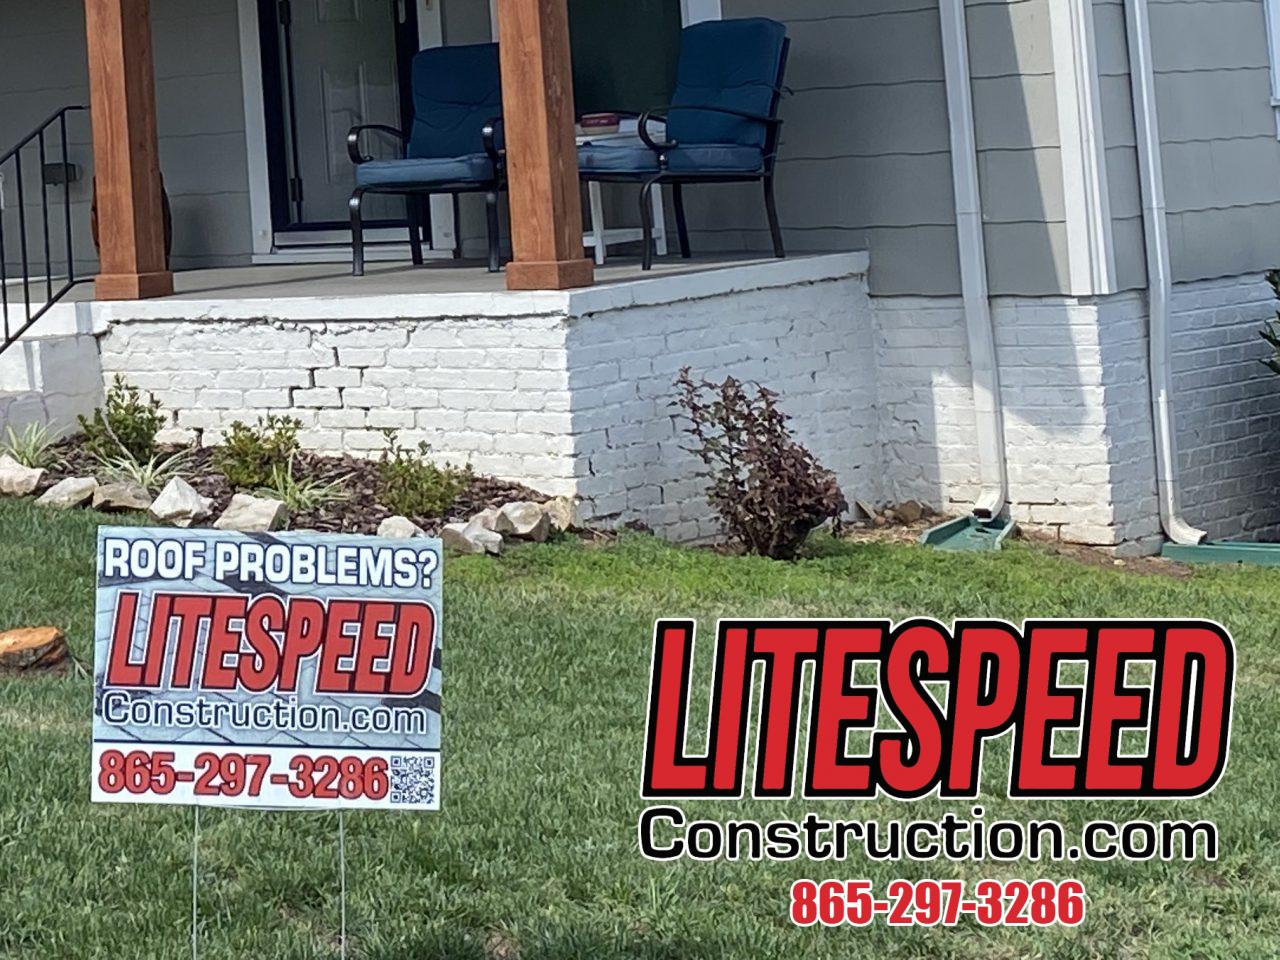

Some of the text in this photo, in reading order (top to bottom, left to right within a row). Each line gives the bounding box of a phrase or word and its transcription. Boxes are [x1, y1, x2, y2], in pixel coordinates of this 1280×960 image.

[104, 538, 438, 589] ROOF PROBLEMS?
[105, 591, 436, 697] LITESPEED
[102, 692, 426, 734] Construction.com
[98, 749, 389, 801] 865-297-3286
